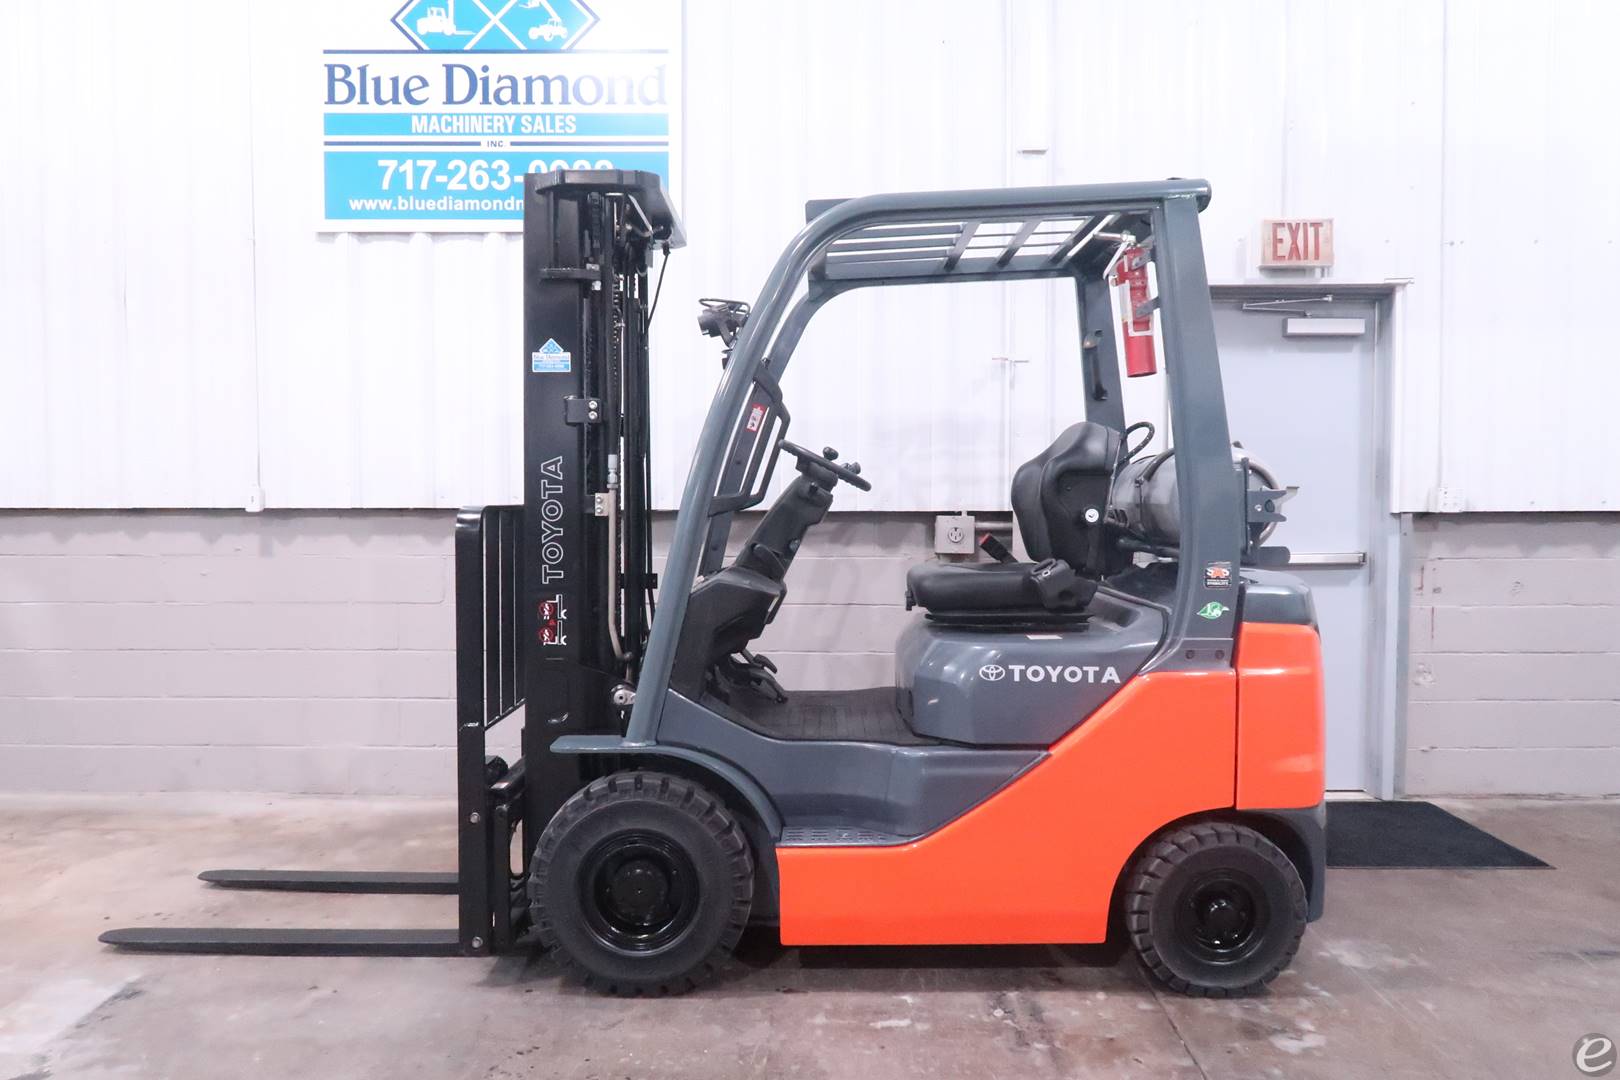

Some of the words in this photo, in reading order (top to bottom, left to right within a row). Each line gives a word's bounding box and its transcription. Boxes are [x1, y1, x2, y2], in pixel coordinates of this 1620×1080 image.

[324, 63, 430, 106] Blue
[442, 63, 667, 107] Diamond
[411, 115, 515, 134] MACHINERY
[520, 114, 577, 134] SALES
[1272, 222, 1323, 261] EXIT
[540, 456, 564, 585] TOYOTA
[1008, 665, 1121, 684] TOYOTA
